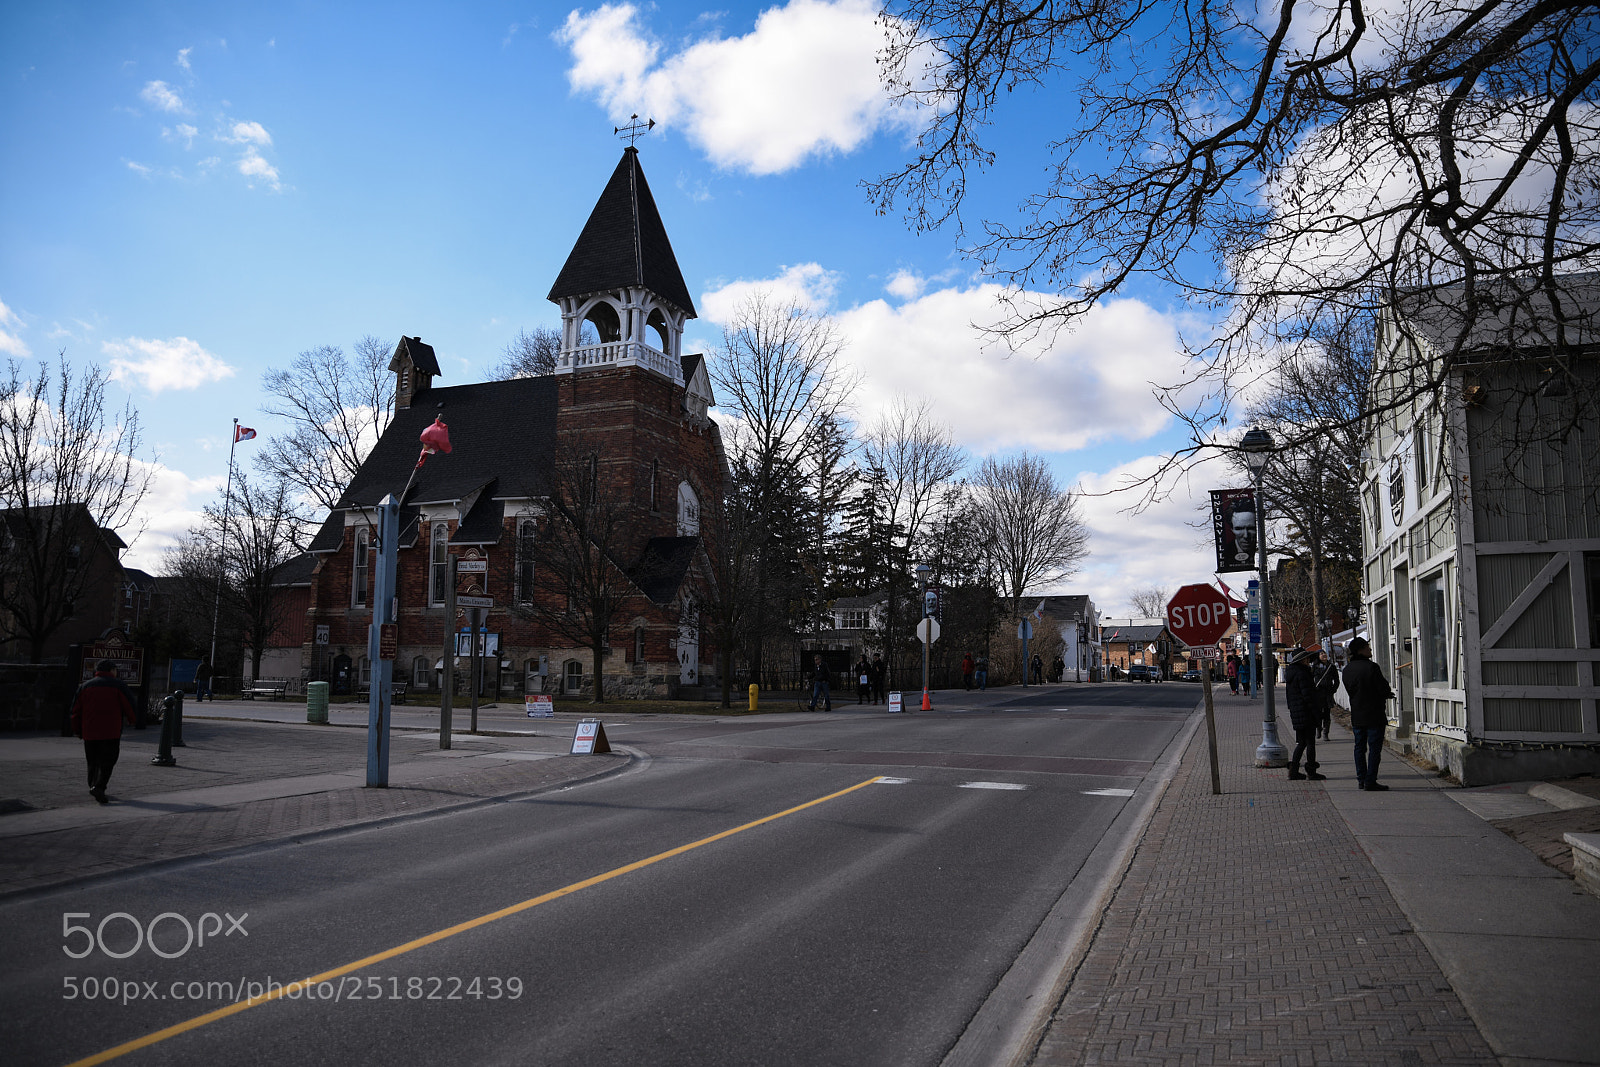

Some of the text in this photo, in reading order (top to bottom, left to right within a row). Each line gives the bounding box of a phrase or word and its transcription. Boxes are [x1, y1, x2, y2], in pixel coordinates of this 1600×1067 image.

[1212, 494, 1225, 568] UNIONVILLE
[1172, 602, 1226, 629] STOP
[317, 633, 328, 642] 40
[93, 648, 136, 659] UNIONVILLE
